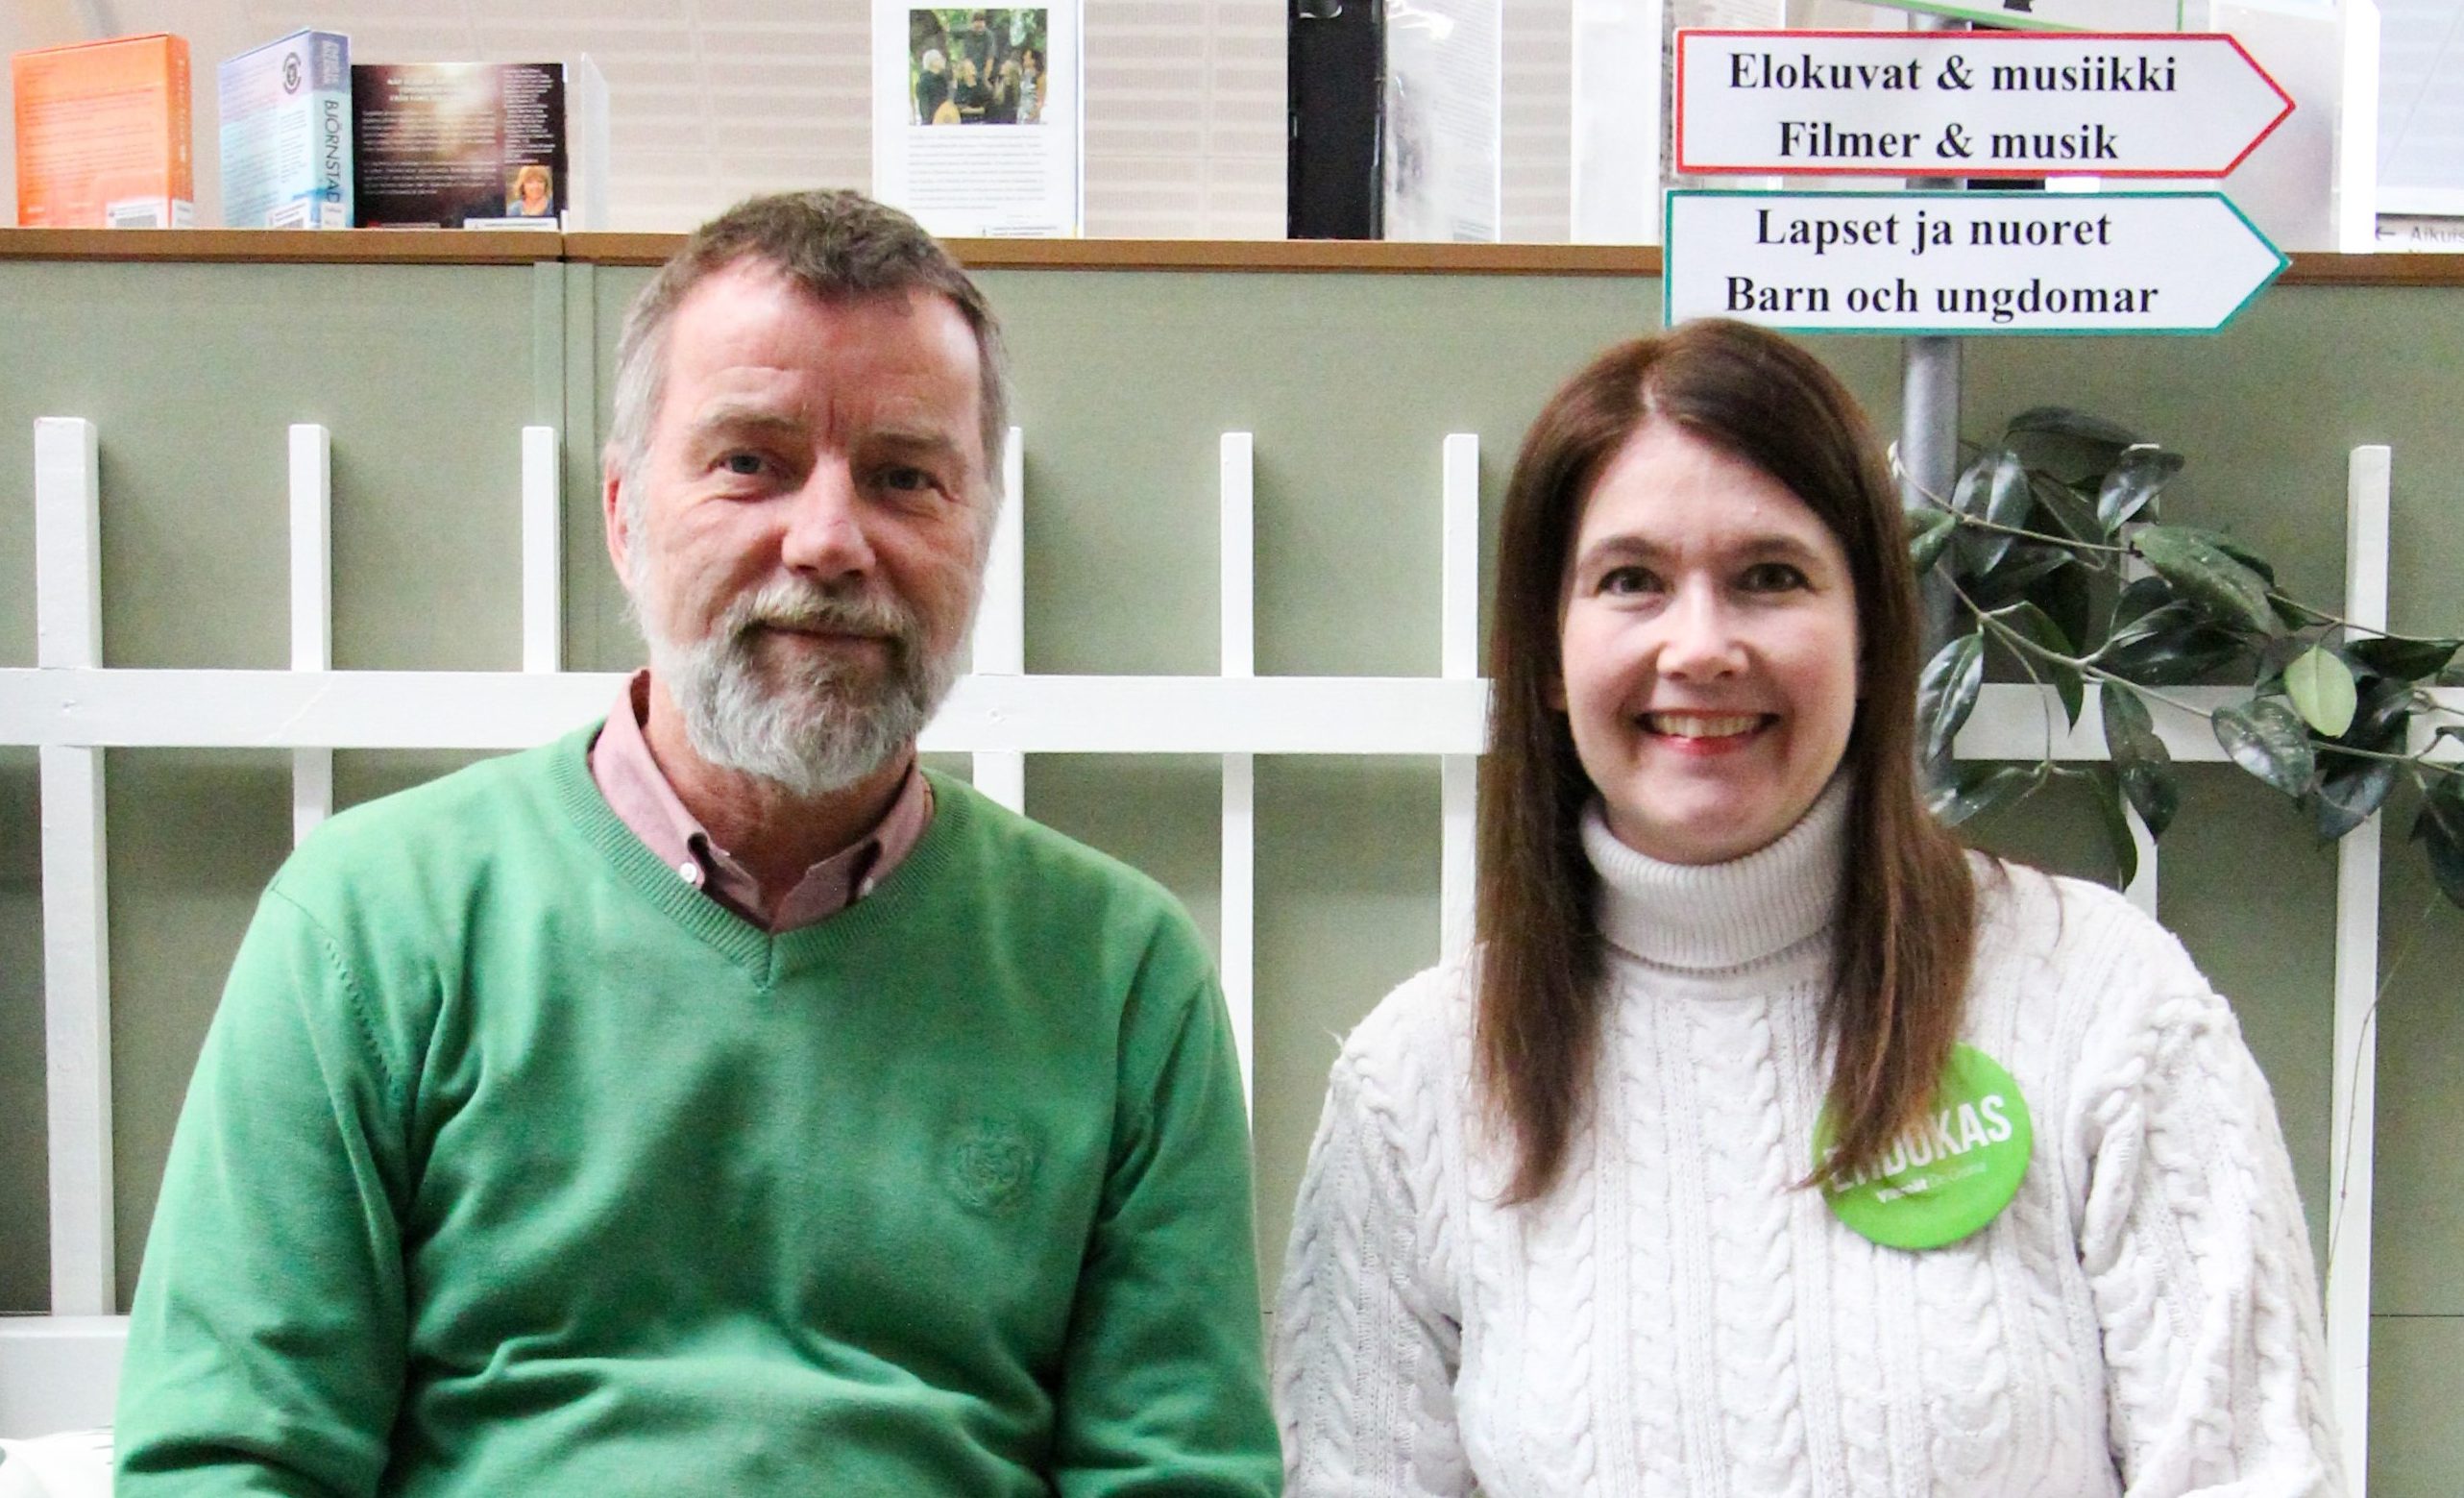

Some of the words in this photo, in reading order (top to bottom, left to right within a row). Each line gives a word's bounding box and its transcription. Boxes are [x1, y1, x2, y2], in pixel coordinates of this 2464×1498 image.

[1729, 53, 1920, 90] Elokuvat
[1937, 56, 1972, 90] &
[1991, 56, 2176, 91] musiikki
[1778, 122, 1920, 158] Filmer
[1936, 124, 1972, 159] &
[1990, 124, 2119, 160] musik
[1756, 209, 1899, 255] Lapset
[1912, 210, 1954, 255] ja
[1970, 215, 2112, 246] nuoret
[1725, 276, 1829, 312] Barn
[1846, 278, 1918, 312] och
[1937, 279, 2159, 323] ungdomar
